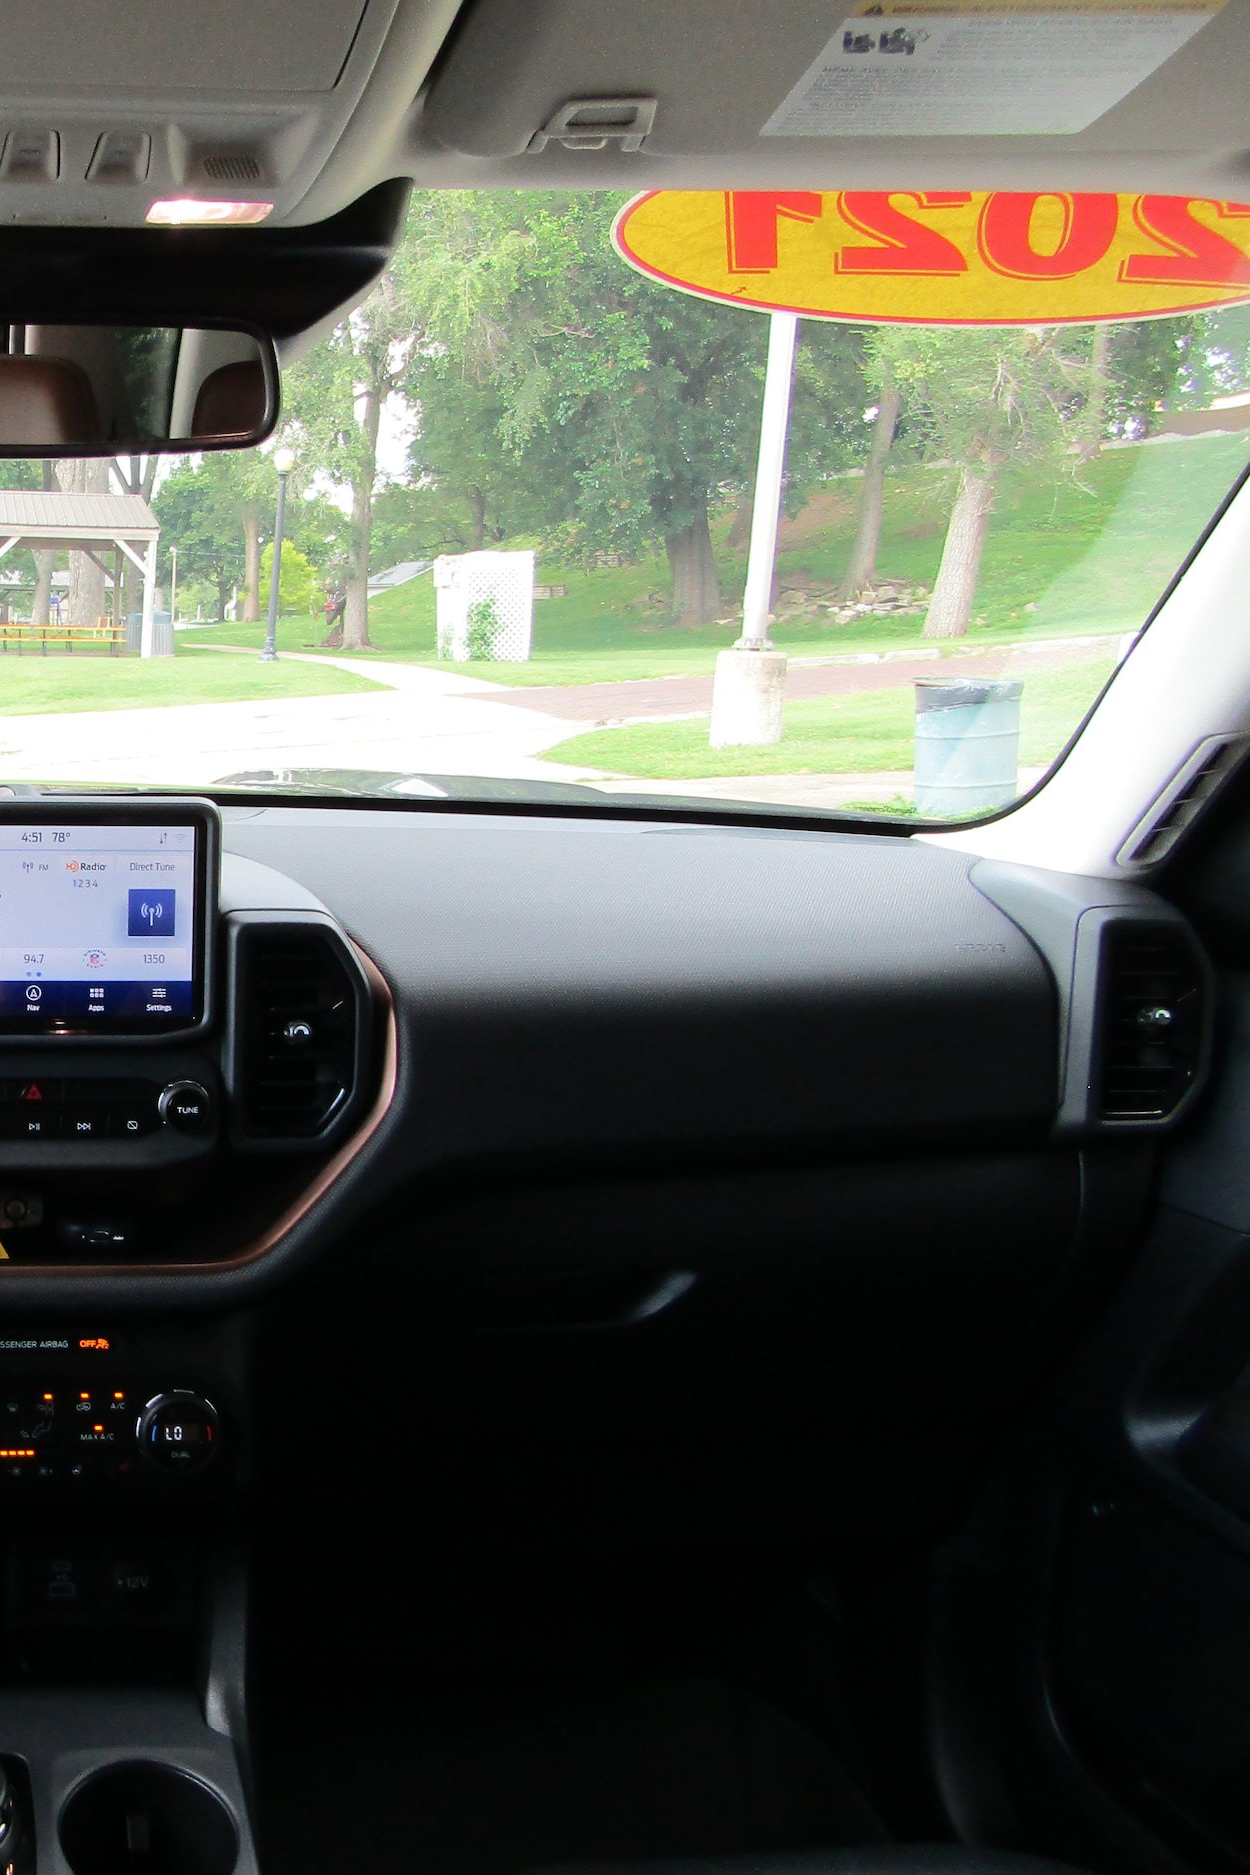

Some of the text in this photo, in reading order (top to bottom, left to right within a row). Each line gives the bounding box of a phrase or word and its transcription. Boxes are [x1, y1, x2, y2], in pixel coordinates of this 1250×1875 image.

[21, 832, 71, 843] 4:51 78°
[80, 862, 106, 871] Radio
[129, 862, 176, 872] Direct Tune
[23, 953, 44, 964] 94.7
[143, 953, 165, 964] 1350
[88, 1004, 104, 1012] Apps
[146, 1003, 172, 1012] Settings
[176, 1106, 199, 1114] TUNE
[39, 1340, 69, 1349] AIRBAG
[79, 1339, 97, 1348] OFF
[110, 1402, 125, 1410] A/C
[79, 1433, 115, 1441] MAX A/C
